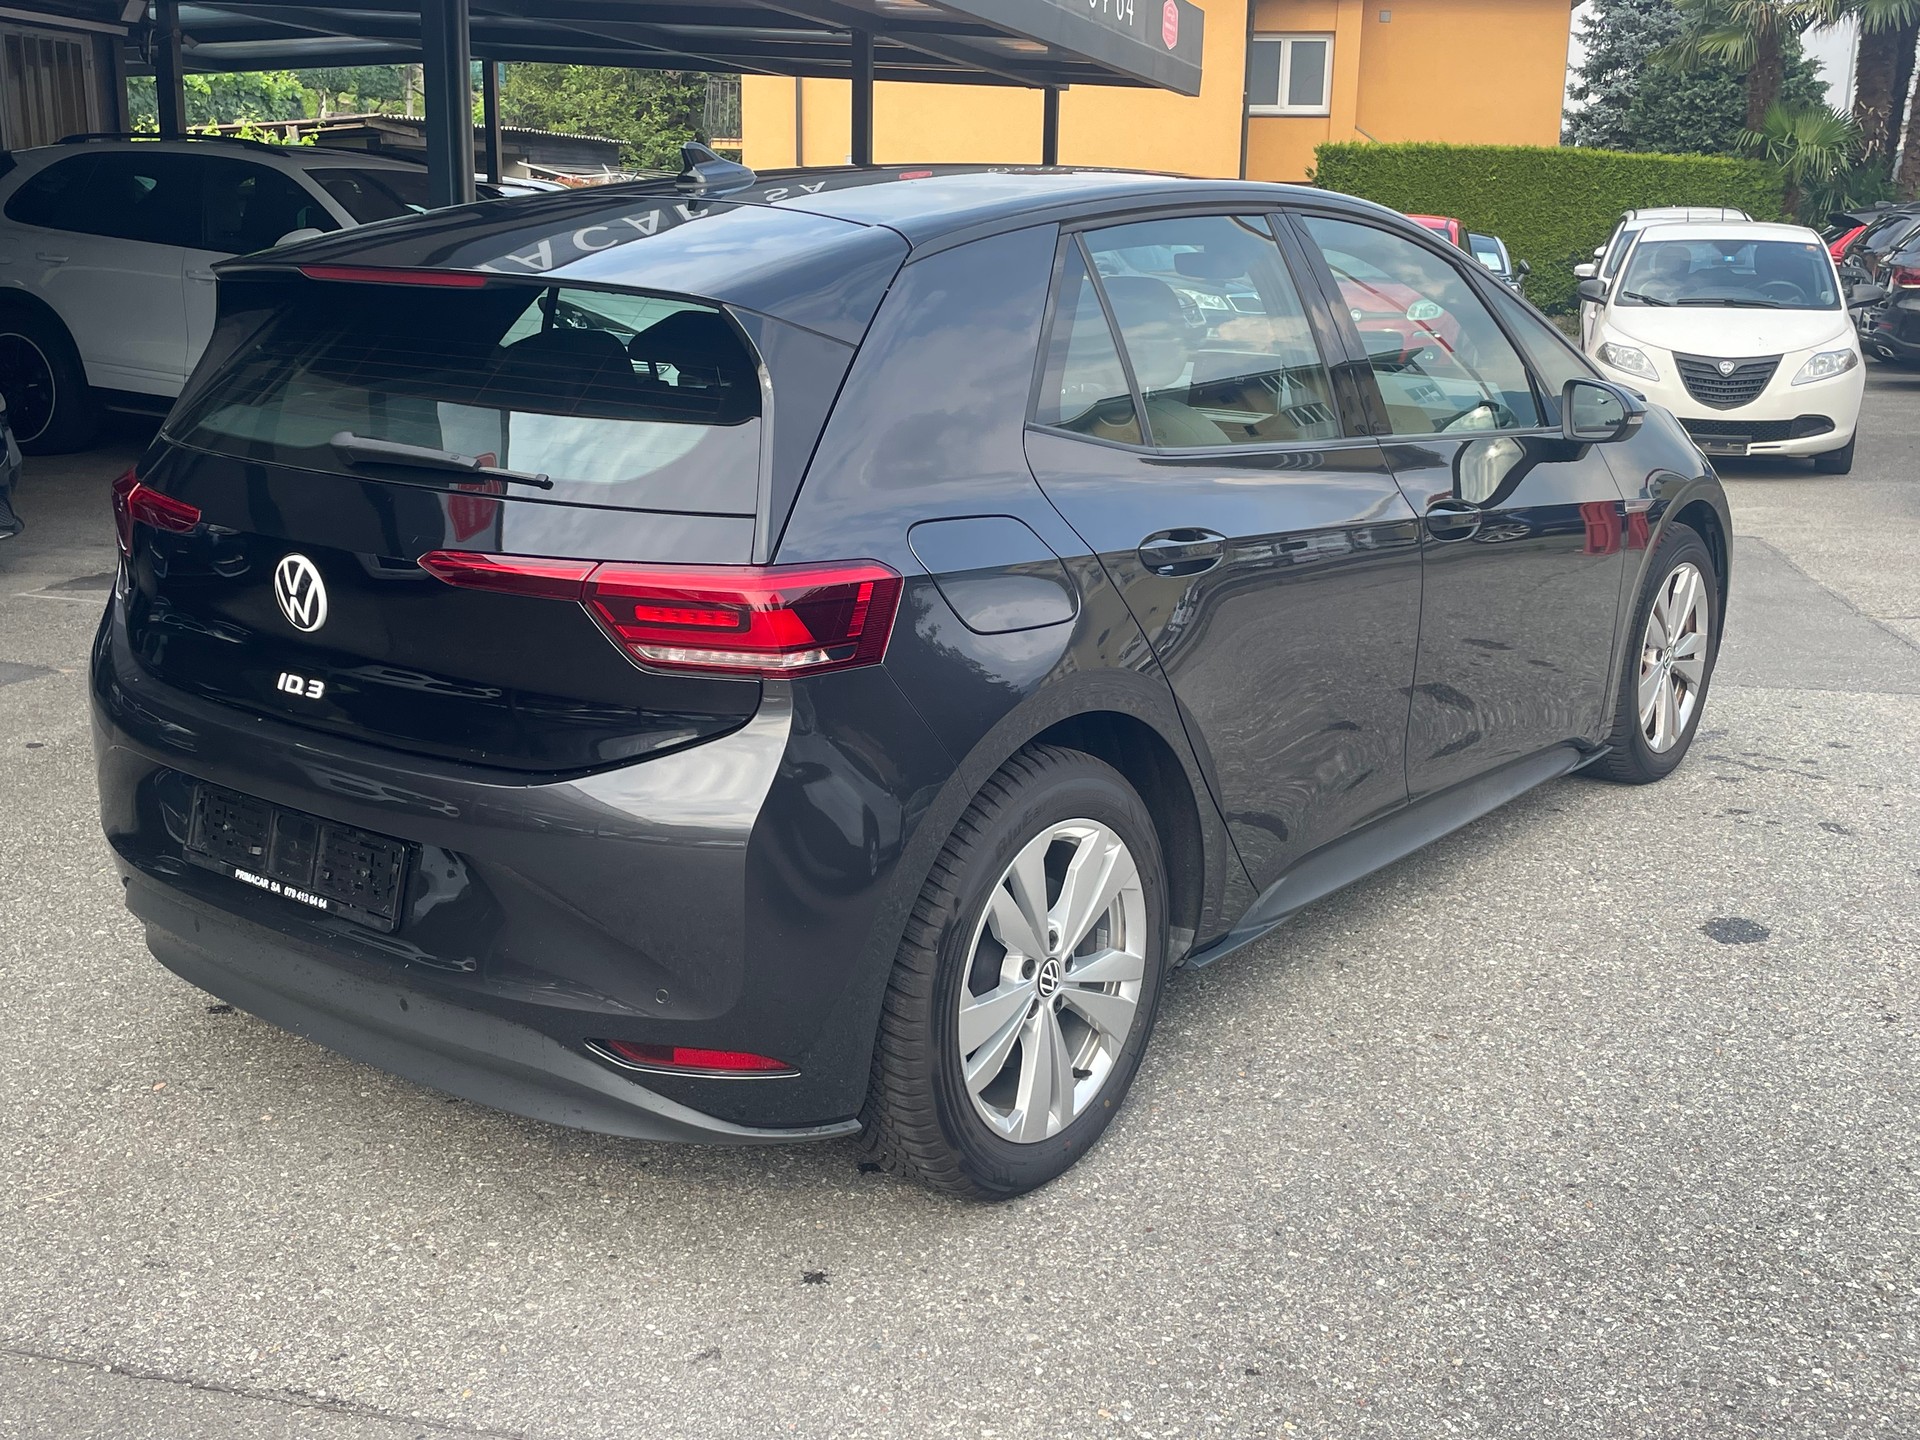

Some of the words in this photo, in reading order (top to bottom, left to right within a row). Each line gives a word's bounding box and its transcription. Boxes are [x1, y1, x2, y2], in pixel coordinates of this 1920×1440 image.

[235, 868, 269, 888] PRIMACAR
[270, 881, 281, 893] SA
[297, 891, 308, 902] 413
